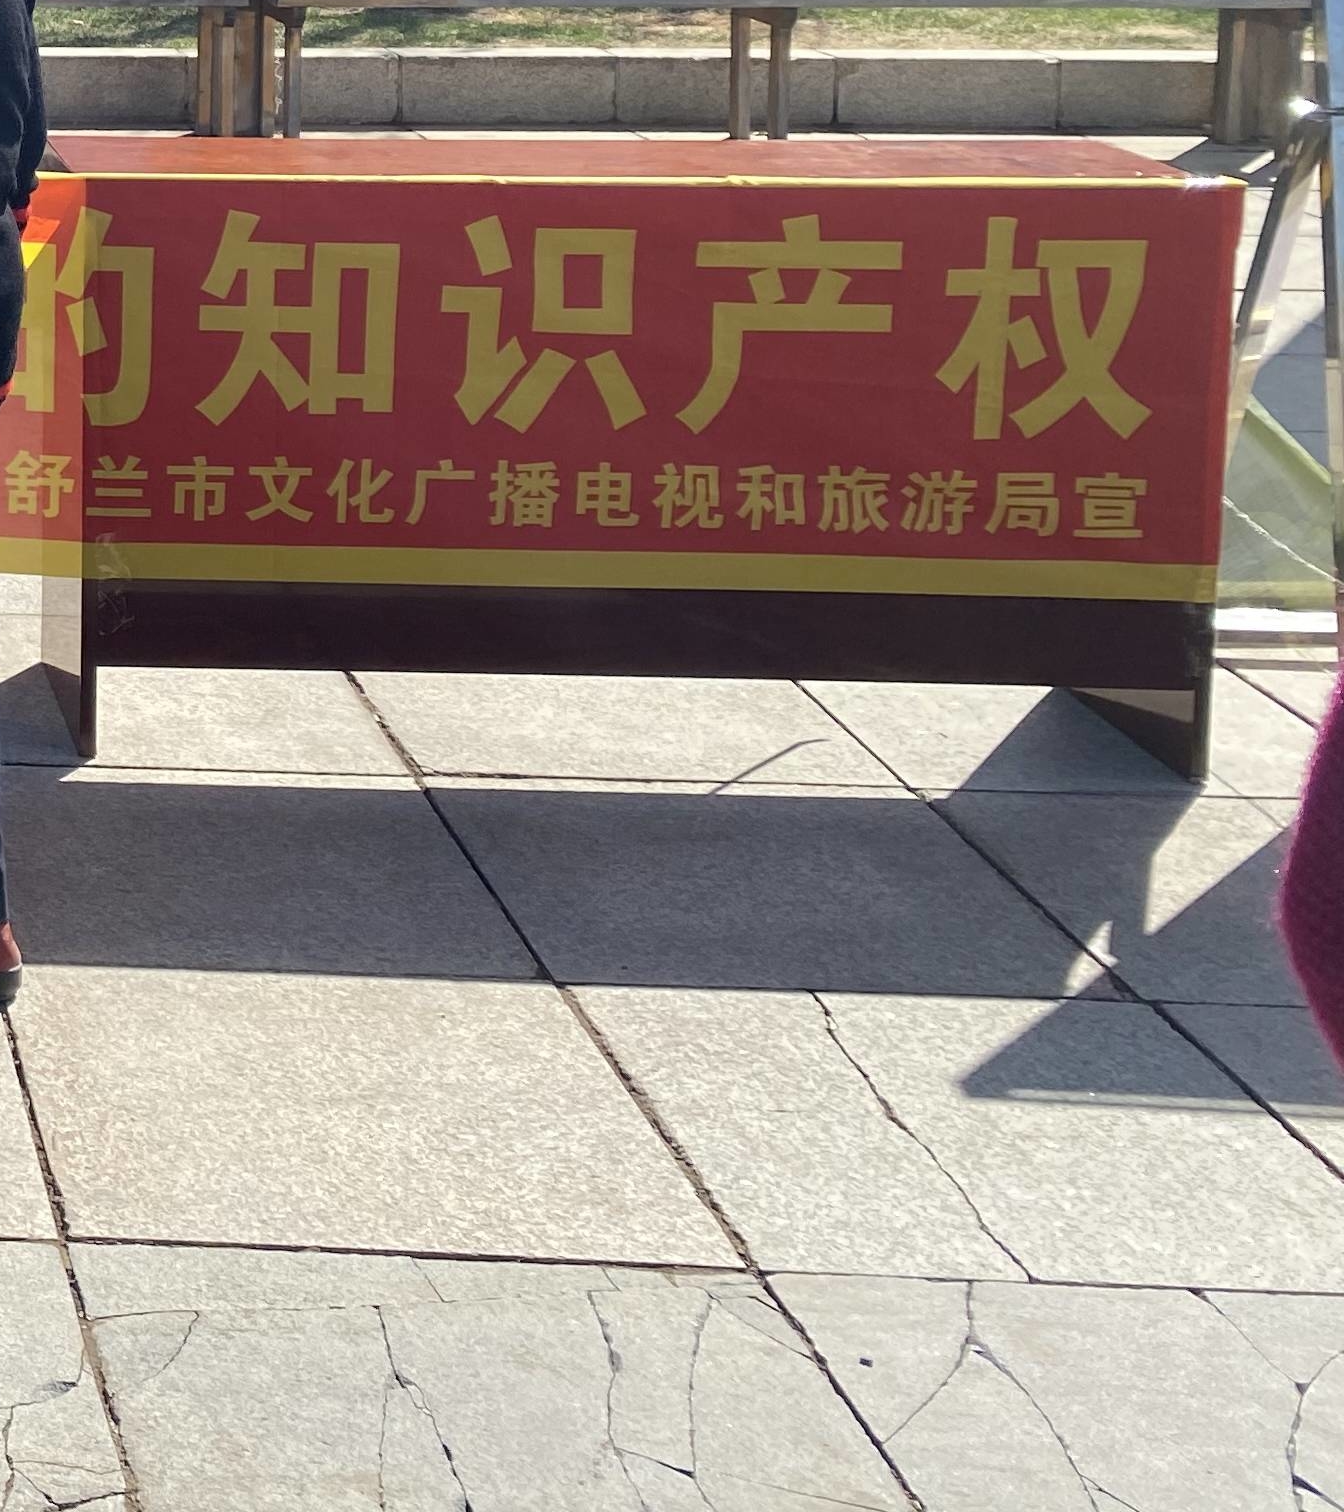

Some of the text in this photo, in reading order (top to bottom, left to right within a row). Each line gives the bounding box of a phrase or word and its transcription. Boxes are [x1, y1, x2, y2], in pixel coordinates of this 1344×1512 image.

[4, 449, 1148, 539] 舒兰市文化广播电视和旅游局宣
